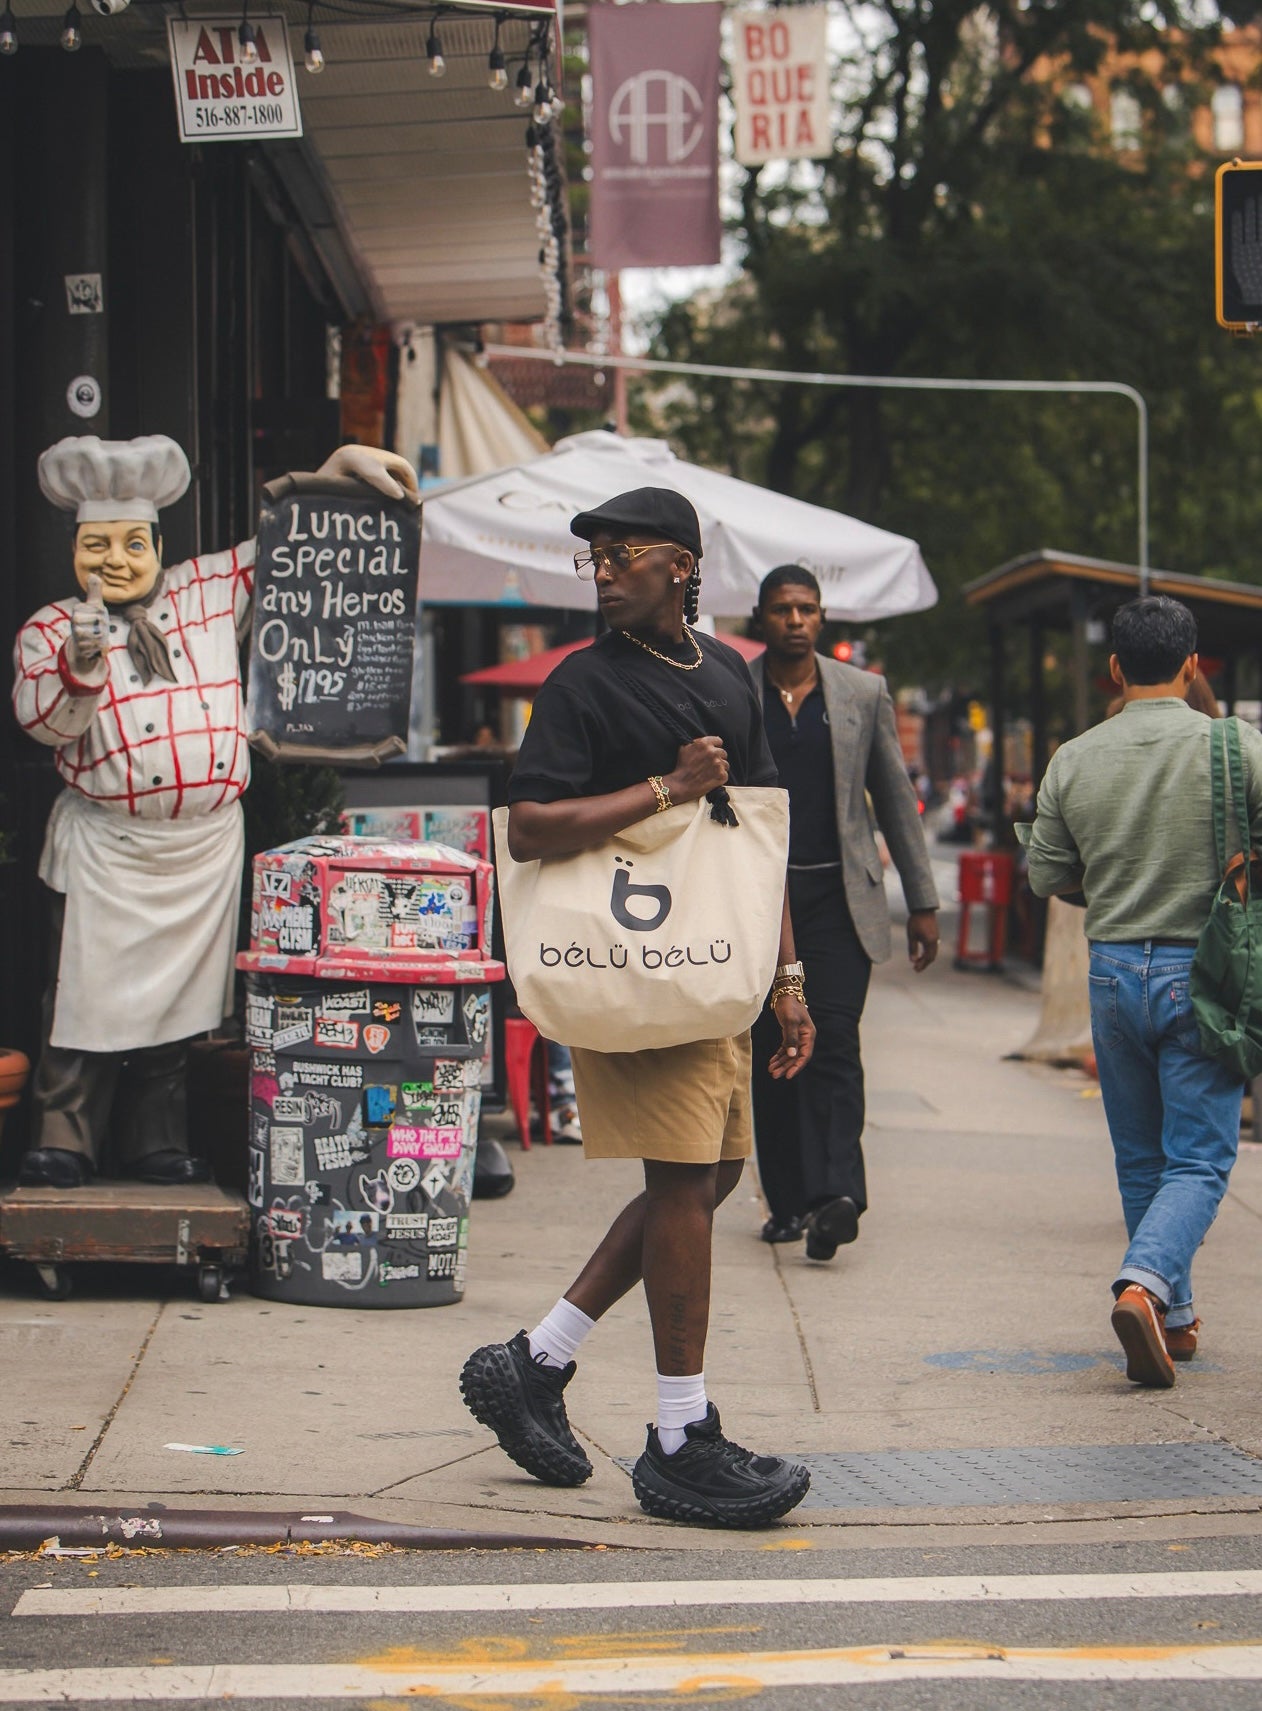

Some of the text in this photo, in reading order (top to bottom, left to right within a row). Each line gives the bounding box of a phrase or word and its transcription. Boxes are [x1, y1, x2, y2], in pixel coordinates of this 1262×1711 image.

[744, 21, 789, 62] BO
[185, 66, 284, 100] Inside
[748, 64, 815, 106] QUE
[196, 104, 283, 128] 516-887-1800
[751, 109, 815, 150] RIA
[288, 503, 402, 542] Lunch
[262, 580, 406, 619] any Heros
[300, 1073, 330, 1086] YACHT
[342, 1065, 363, 1077] HAS
[387, 1229, 426, 1239] JESUS
[389, 1216, 425, 1226] TRUST
